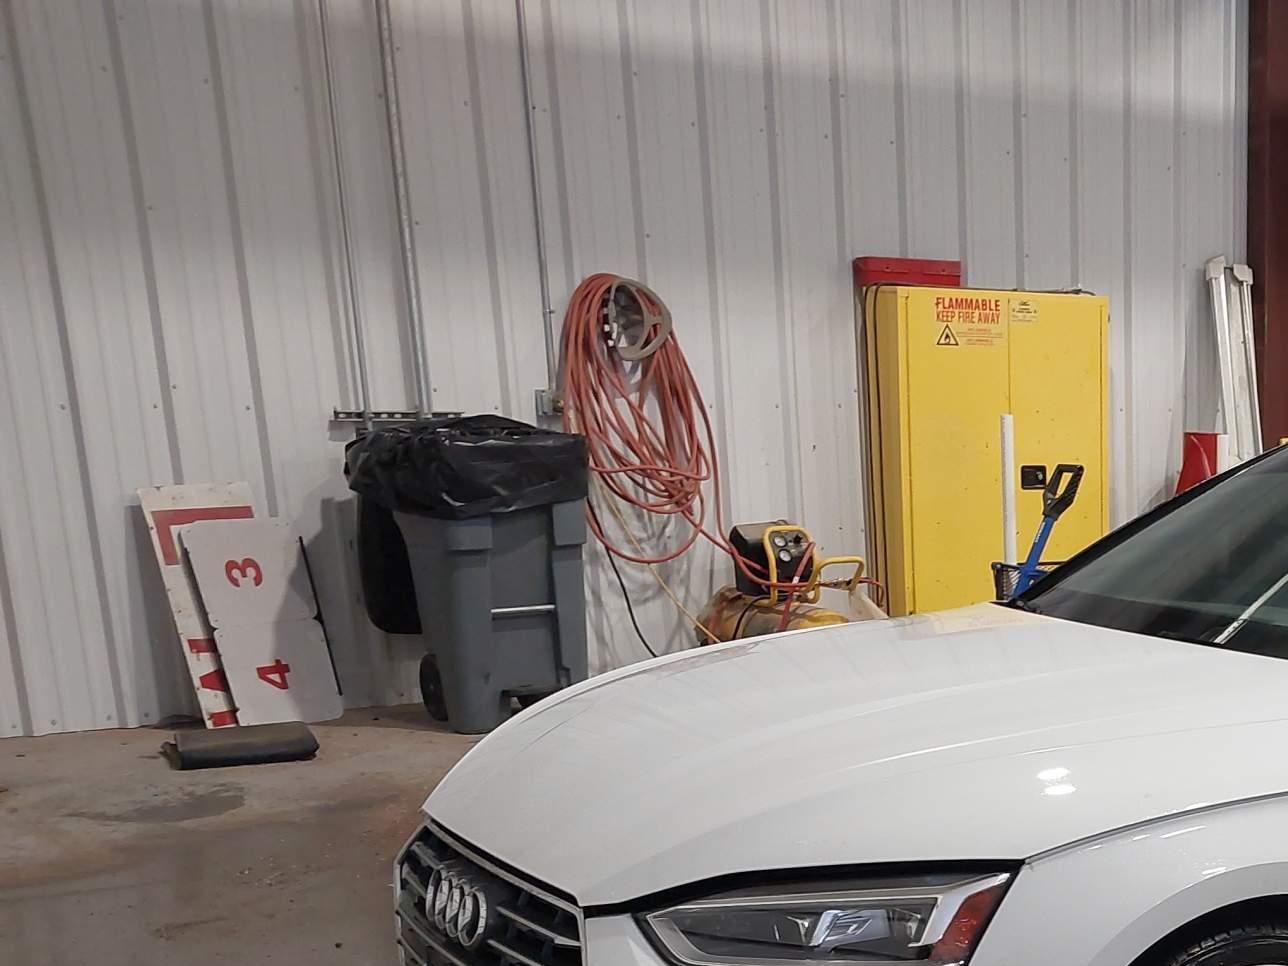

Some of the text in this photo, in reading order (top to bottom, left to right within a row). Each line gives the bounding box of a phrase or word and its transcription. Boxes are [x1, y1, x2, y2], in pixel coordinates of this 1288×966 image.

[935, 297, 1000, 311] FLAMMABLE
[936, 310, 955, 322] KEEP
[958, 311, 975, 323] FIRE
[978, 312, 1000, 324] AWAY
[225, 558, 263, 587] 3
[256, 659, 290, 690] 4
